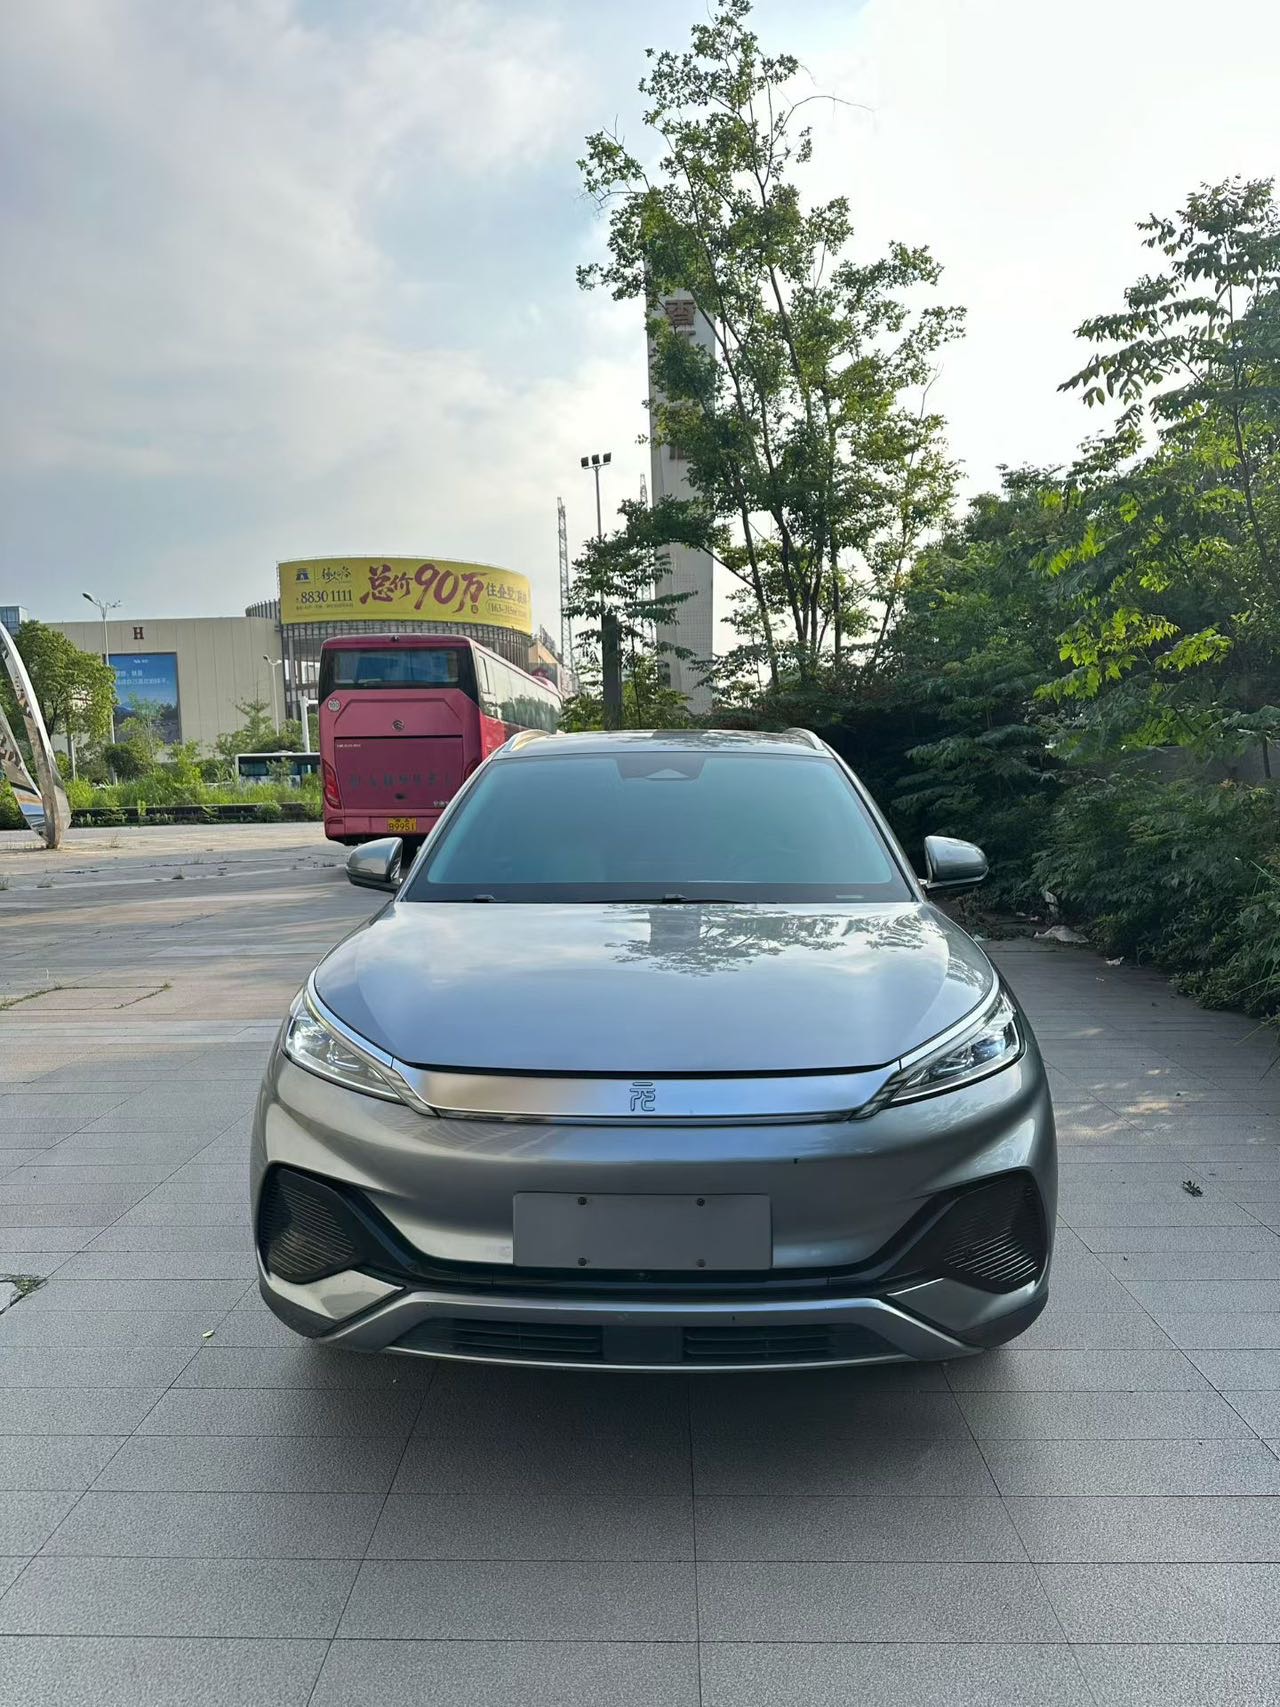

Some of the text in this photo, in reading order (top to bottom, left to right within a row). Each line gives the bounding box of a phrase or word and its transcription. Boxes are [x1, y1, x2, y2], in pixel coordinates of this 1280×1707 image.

[301, 589, 353, 603] 8830 1111
[133, 626, 145, 640] H
